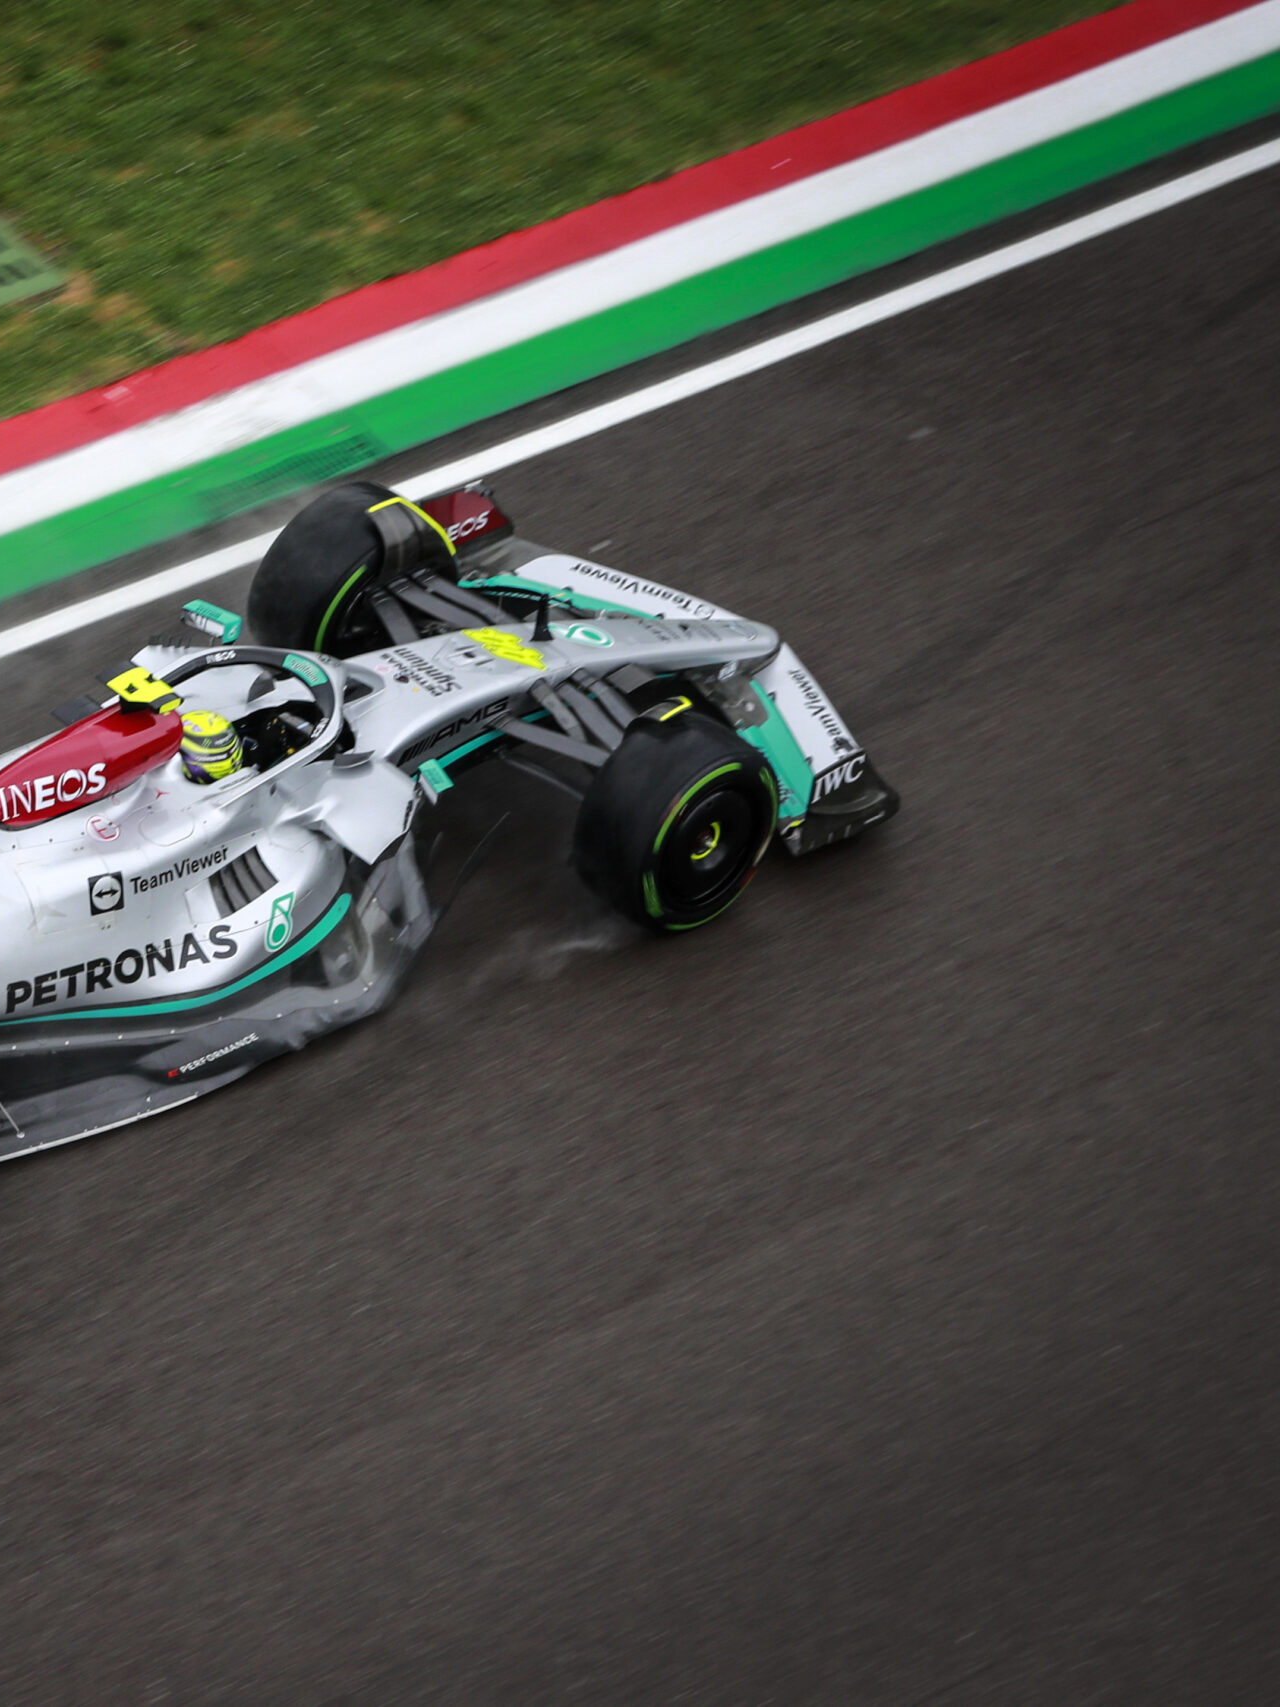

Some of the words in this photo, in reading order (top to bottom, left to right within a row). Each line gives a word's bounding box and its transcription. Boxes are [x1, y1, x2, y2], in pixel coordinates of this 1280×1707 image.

[447, 510, 490, 542] EOS
[570, 563, 694, 614] TeamViewer
[811, 754, 866, 804] IWC
[130, 845, 229, 895] TeamViewer
[5, 924, 238, 1014] PETRONAS
[180, 1032, 259, 1073] PERFORMANCE
